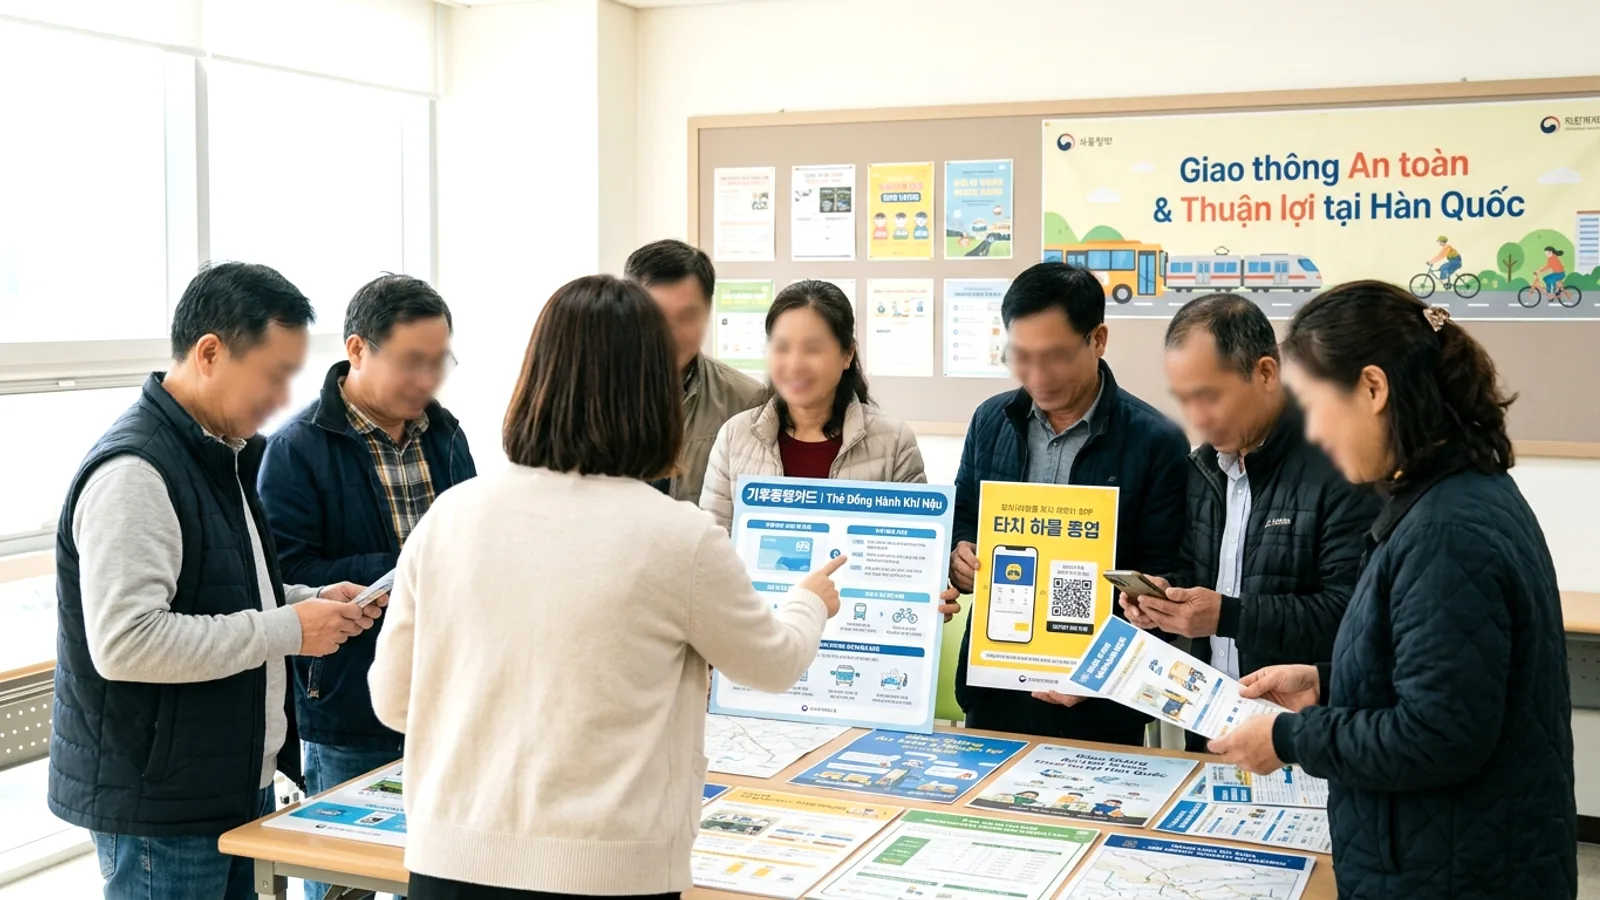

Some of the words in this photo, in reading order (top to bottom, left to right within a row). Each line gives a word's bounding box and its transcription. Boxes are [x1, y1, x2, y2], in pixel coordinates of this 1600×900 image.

[1180, 156, 1245, 183] Giao
[1252, 152, 1340, 187] thông
[1348, 151, 1390, 179] An
[1399, 147, 1469, 178] toàn
[1153, 196, 1172, 223] &
[1180, 194, 1272, 228] Thuận
[1281, 193, 1315, 228] lợi
[1323, 192, 1361, 227] tại
[1370, 190, 1431, 219] Hàn
[1441, 186, 1525, 222] Quốc
[993, 515, 1025, 534] 타치
